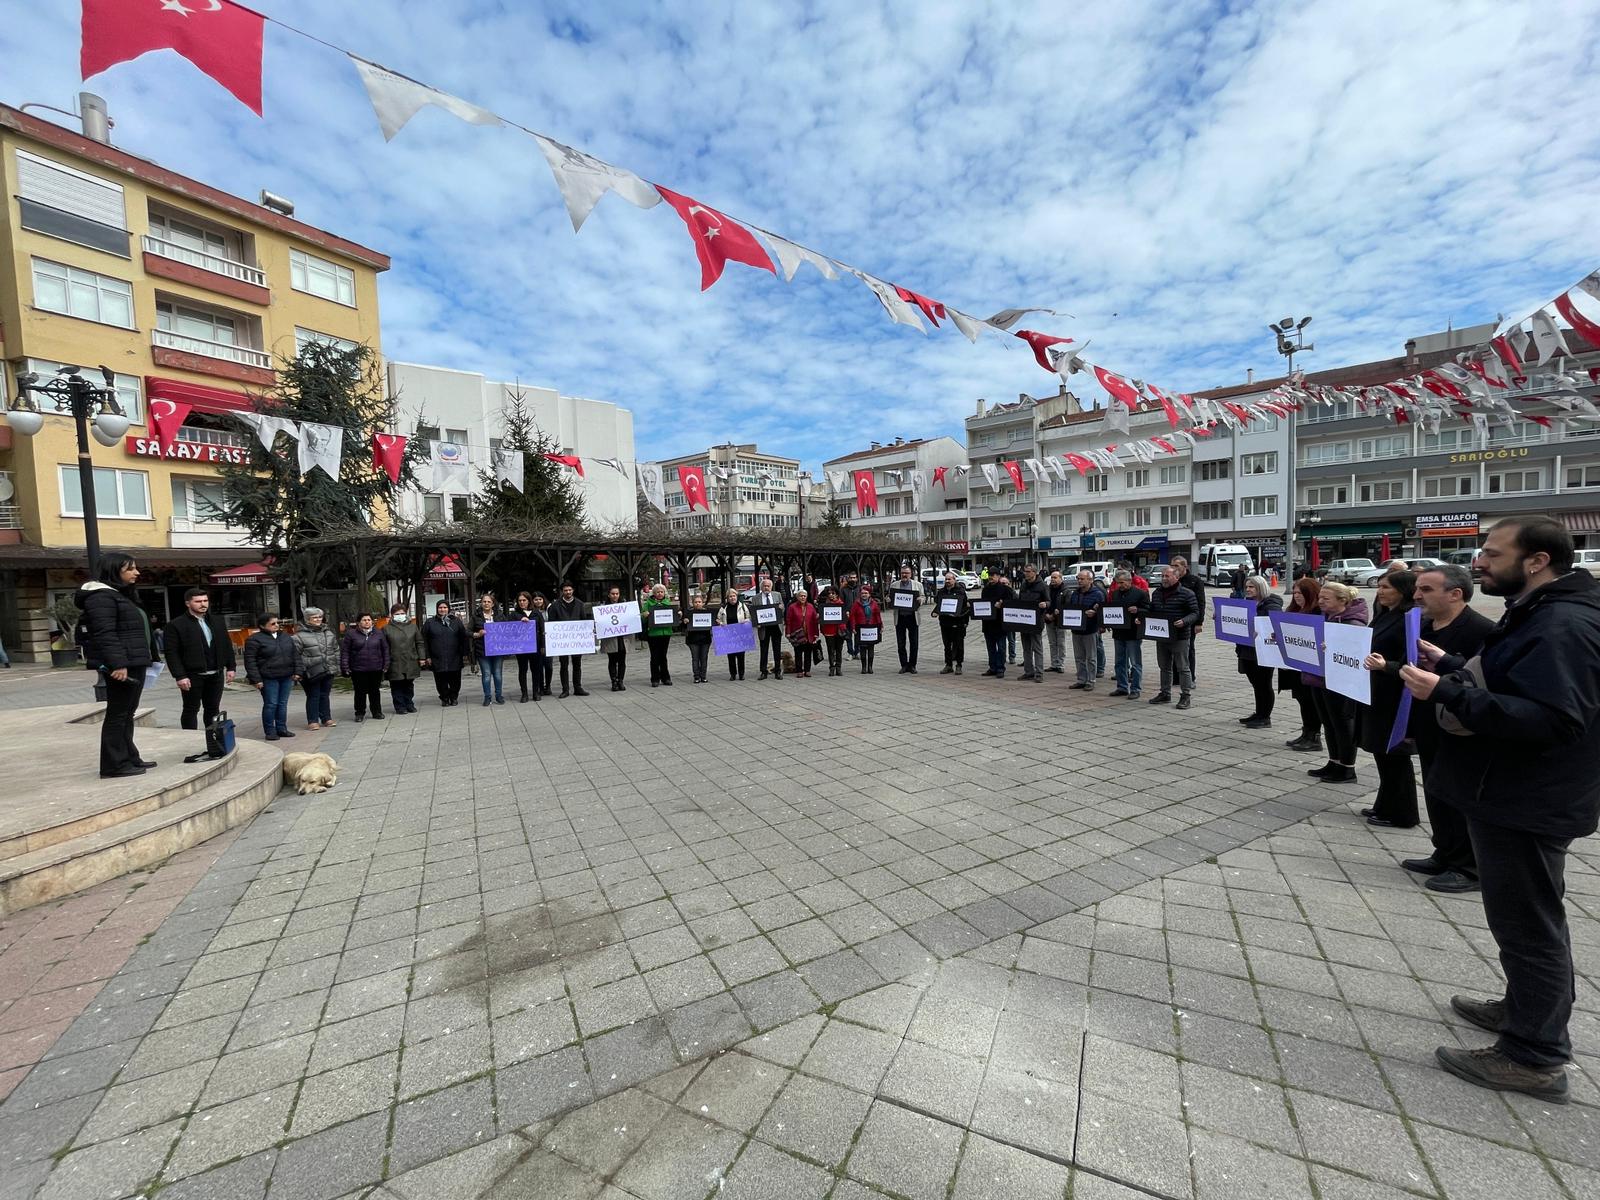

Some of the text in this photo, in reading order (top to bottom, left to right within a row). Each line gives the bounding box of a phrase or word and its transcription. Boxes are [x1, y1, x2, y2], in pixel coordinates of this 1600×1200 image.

[136, 439, 203, 459] SARAY
[1450, 448, 1529, 463] SARIOĞLU
[770, 480, 786, 488] OTEL
[1416, 513, 1478, 523] EMSA KUAFÖR
[611, 615, 619, 626] 8
[1221, 615, 1248, 626] BEDENİMİZ
[604, 625, 628, 635] MART
[1284, 635, 1317, 650] EMEĞİMİZ
[1333, 652, 1360, 670] BİZİMDİR
